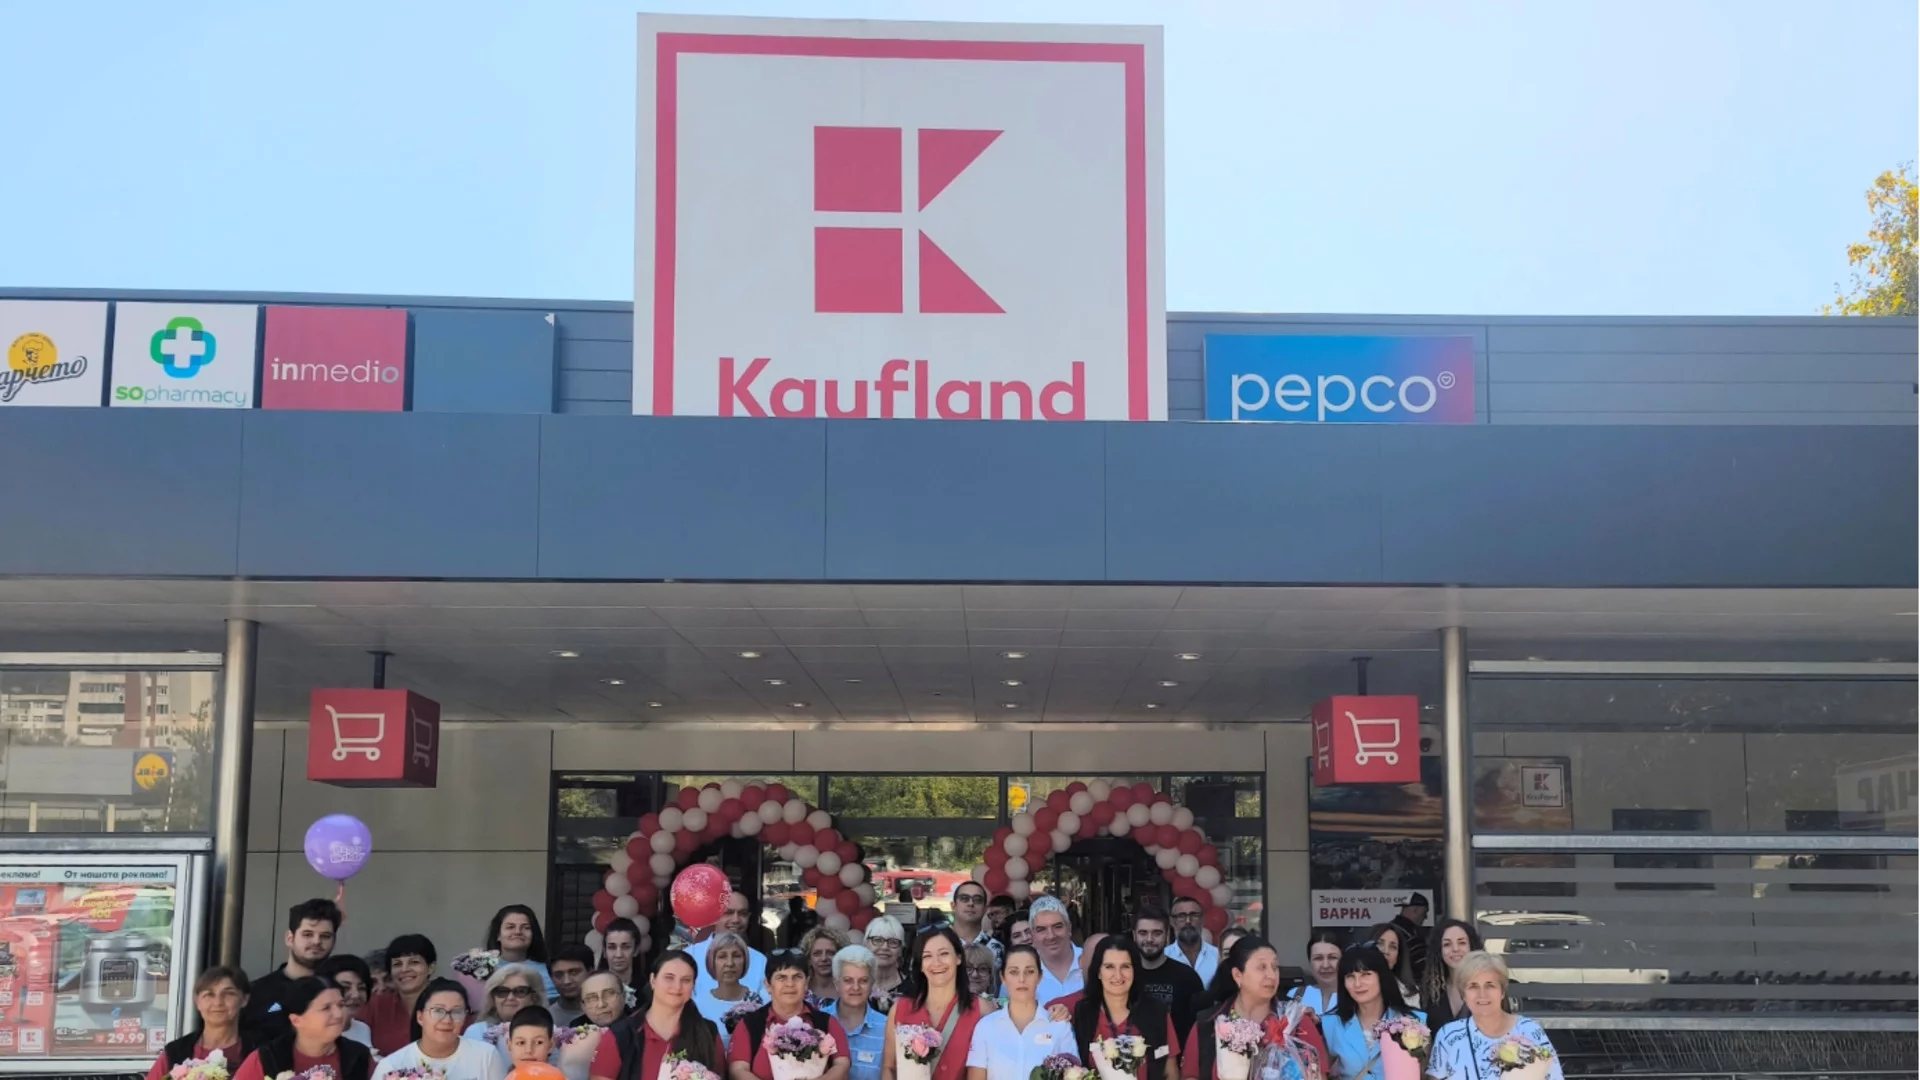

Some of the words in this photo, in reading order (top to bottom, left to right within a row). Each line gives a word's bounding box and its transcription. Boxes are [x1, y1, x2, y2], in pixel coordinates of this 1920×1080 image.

[271, 357, 400, 384] inmedio
[115, 385, 247, 408] sopharmacy
[718, 357, 1085, 421] Kaufland
[1231, 373, 1437, 422] pepco
[64, 870, 78, 879] От
[121, 870, 168, 880] реклама!
[1319, 907, 1371, 920] ВАРНА
[107, 1032, 145, 1044] 29.99
